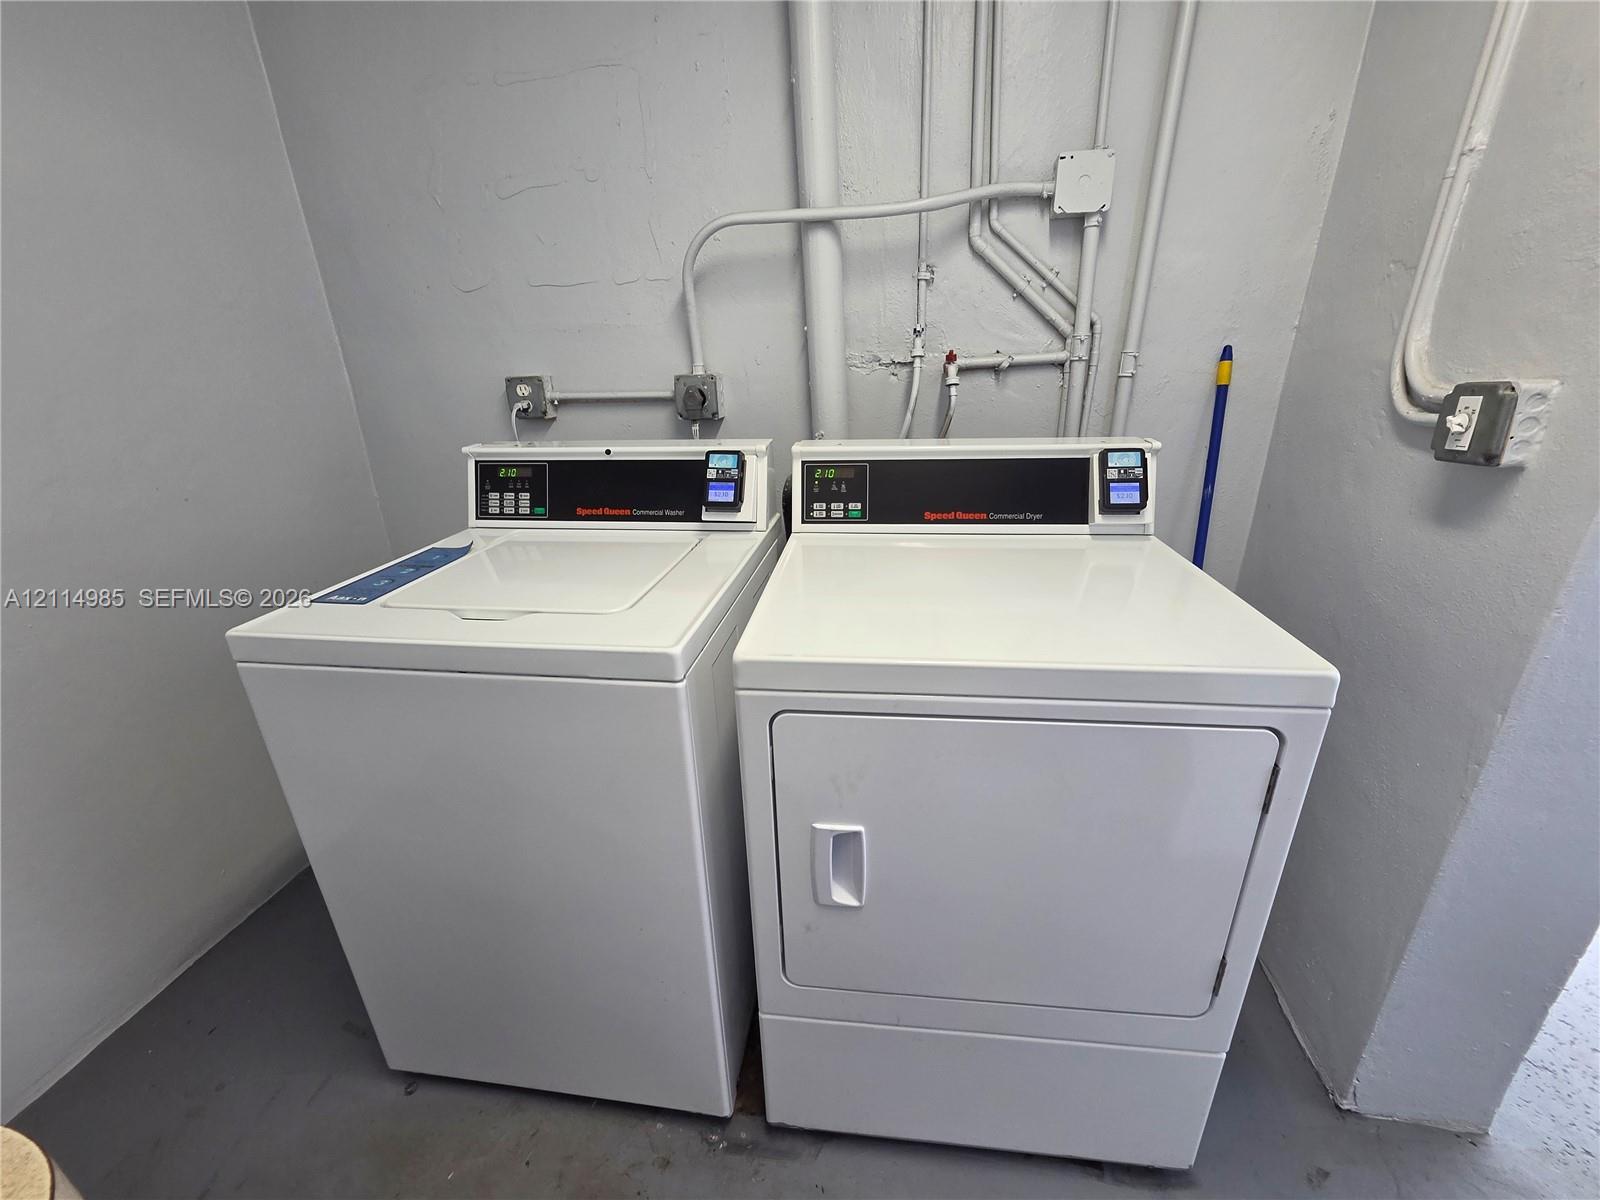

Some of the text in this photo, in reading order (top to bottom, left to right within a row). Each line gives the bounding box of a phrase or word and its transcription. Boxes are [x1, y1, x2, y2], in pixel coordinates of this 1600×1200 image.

[575, 507, 685, 517] Speed Queen Commercial Washer
[924, 511, 1043, 521] Speed Queen Commercial Dryer
